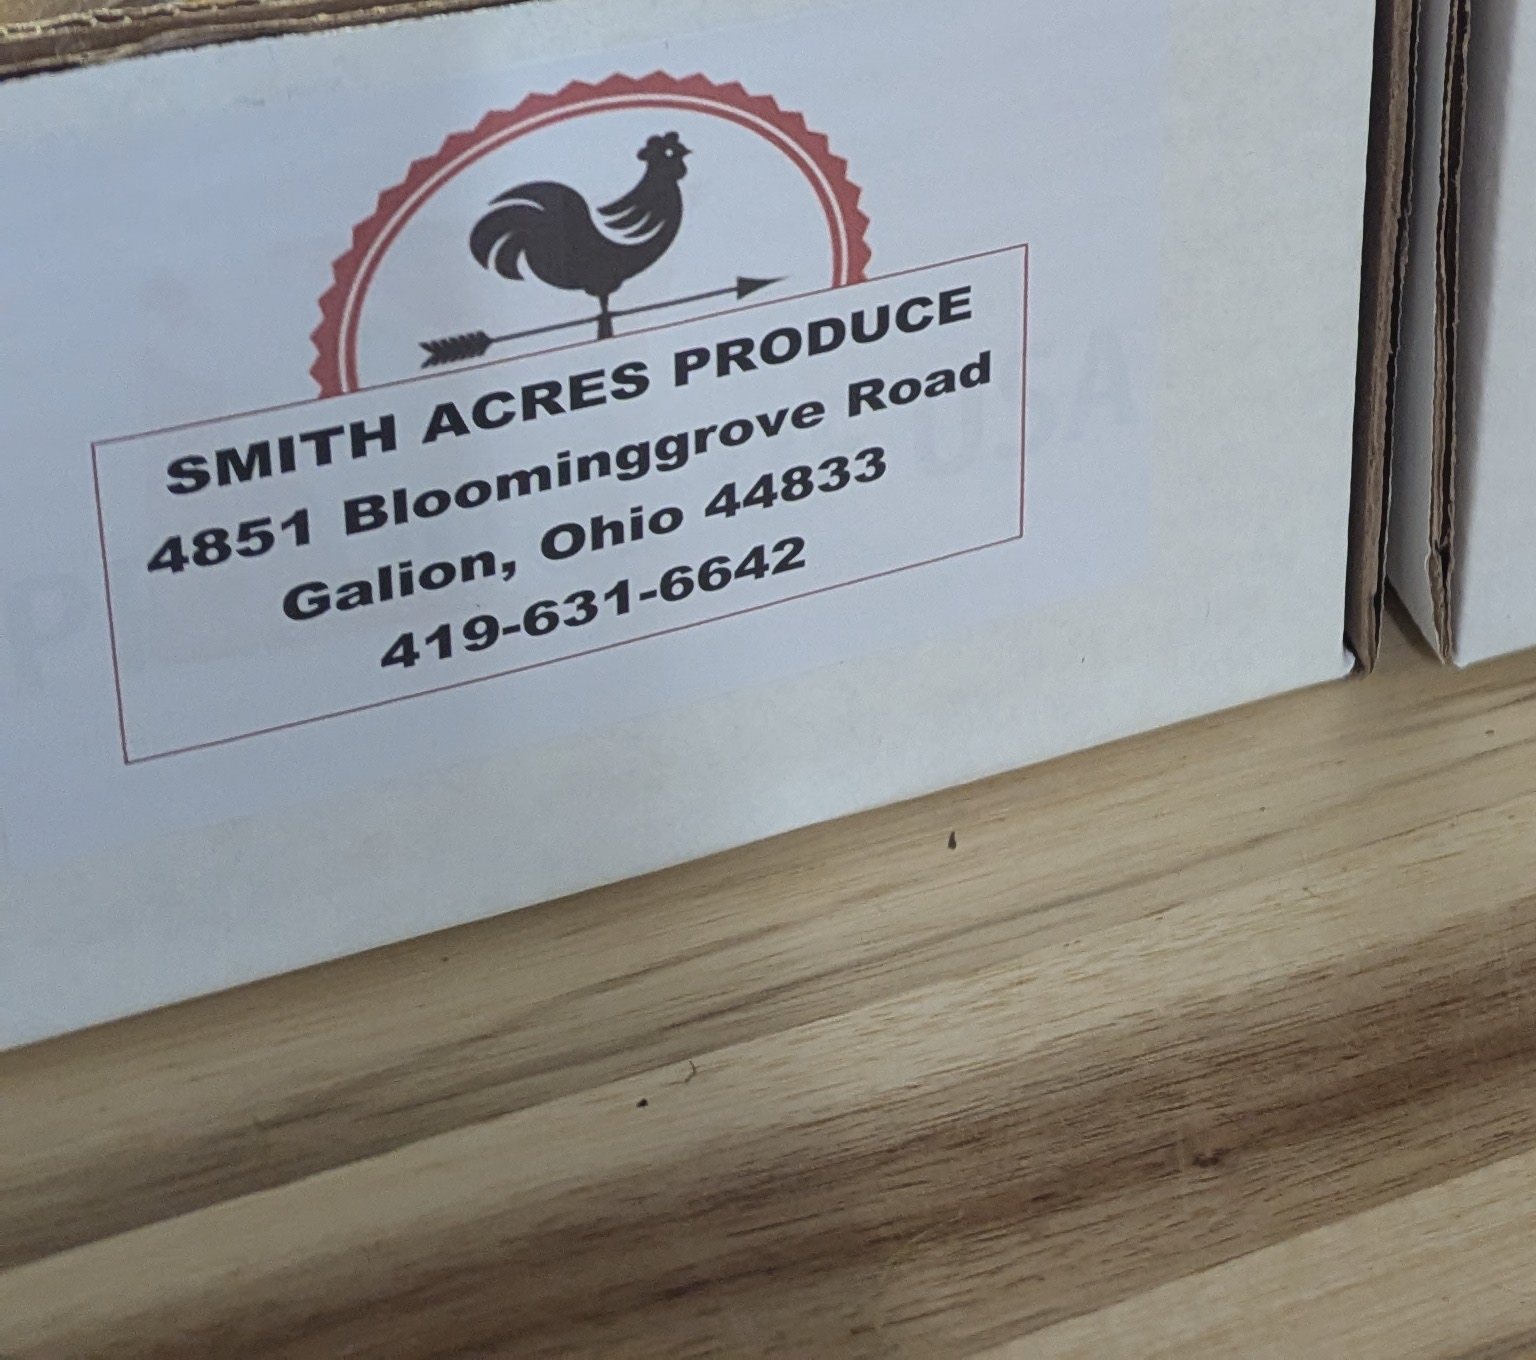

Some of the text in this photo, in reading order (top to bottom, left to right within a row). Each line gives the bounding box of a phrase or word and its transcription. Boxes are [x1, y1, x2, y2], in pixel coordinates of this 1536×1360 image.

[147, 508, 310, 574] 4851
[344, 394, 826, 536] Bloominggrove
[849, 350, 991, 417] Road
[167, 286, 972, 495] SMITH ACRES PRODUCE
[283, 447, 886, 620] Galion, Ohio 44833
[378, 537, 805, 668] 419-631-6642
